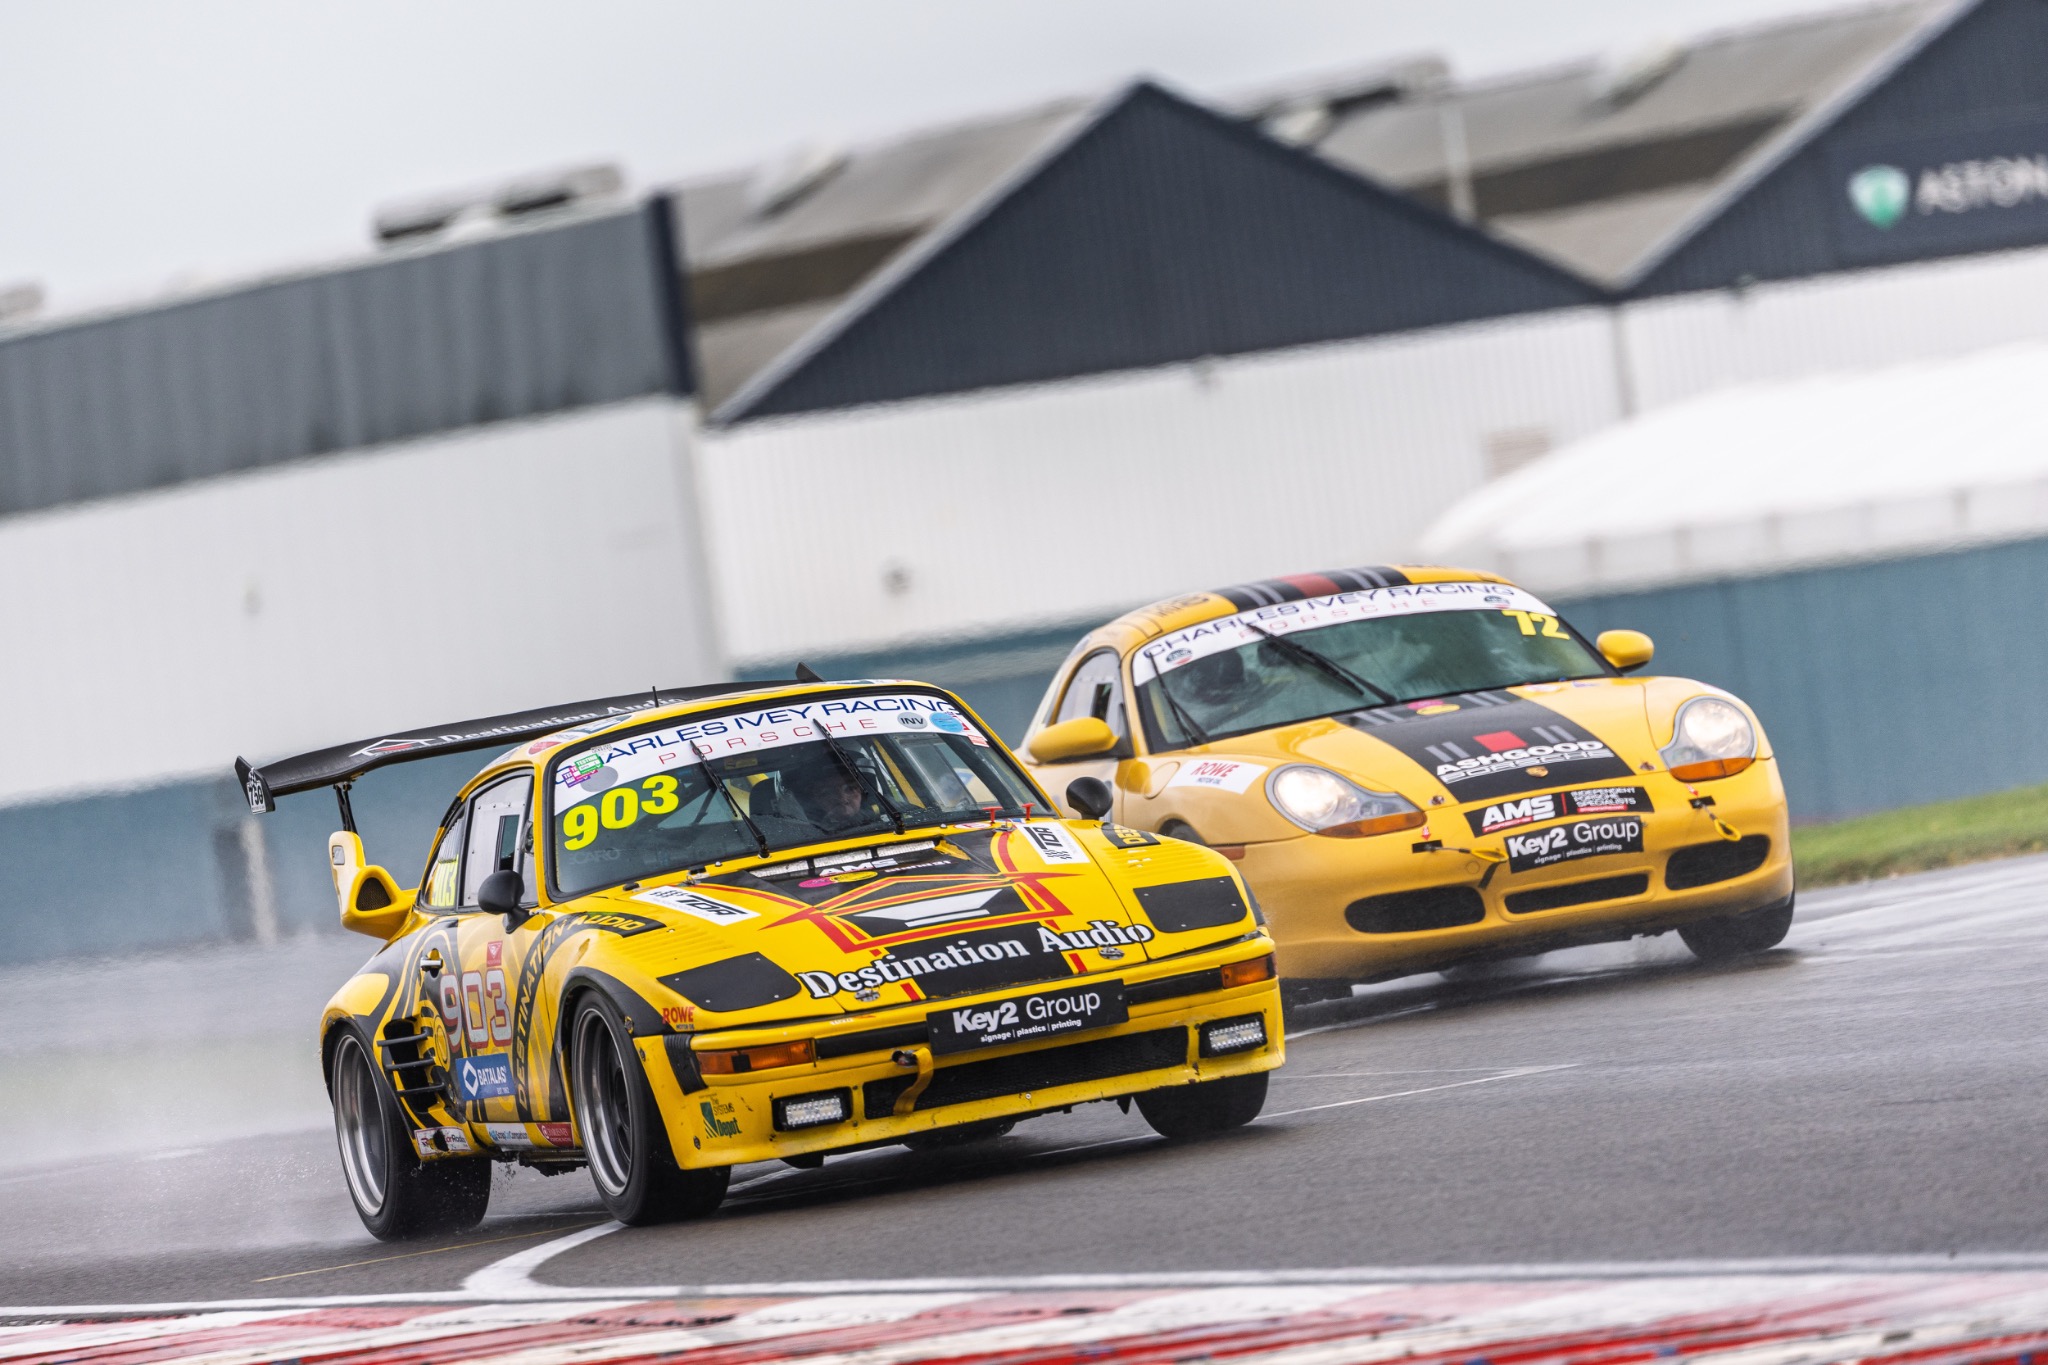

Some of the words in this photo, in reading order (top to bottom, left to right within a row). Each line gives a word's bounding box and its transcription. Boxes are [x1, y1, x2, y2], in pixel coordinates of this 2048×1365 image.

[1142, 603, 1300, 659] CHARLES
[1306, 589, 1386, 611] IVEY
[1388, 583, 1516, 598] RACING
[1238, 598, 1438, 640] PORSCHE
[1502, 609, 1571, 640] 72
[439, 711, 598, 744] Destination
[900, 717, 924, 726] INV
[555, 722, 729, 785] ARLES
[734, 705, 812, 730] IVEY
[821, 697, 959, 717] RACING
[658, 718, 878, 765] PORSCHE
[1436, 740, 1604, 777] ASHGOOD
[1190, 762, 1240, 778] ROWE
[562, 775, 680, 852] 903
[1482, 794, 1555, 828] AMS
[1507, 827, 1569, 859] Key2
[1573, 821, 1640, 844] Group
[1534, 852, 1562, 865] signage
[431, 856, 459, 907] 903
[819, 858, 898, 877] AMS
[799, 940, 1031, 1000] Destination
[1036, 919, 1153, 954] Audio
[439, 967, 513, 1054] 903
[518, 919, 565, 1113] DESTINATION
[567, 913, 648, 932] AUDIO
[662, 1005, 696, 1025] ROWE
[952, 1001, 1020, 1034] Key2
[1025, 992, 1101, 1020] Group
[980, 1029, 1012, 1043] signage
[1016, 1024, 1047, 1038] plastics
[1051, 1018, 1082, 1032] printing
[716, 1117, 743, 1139] Depot
